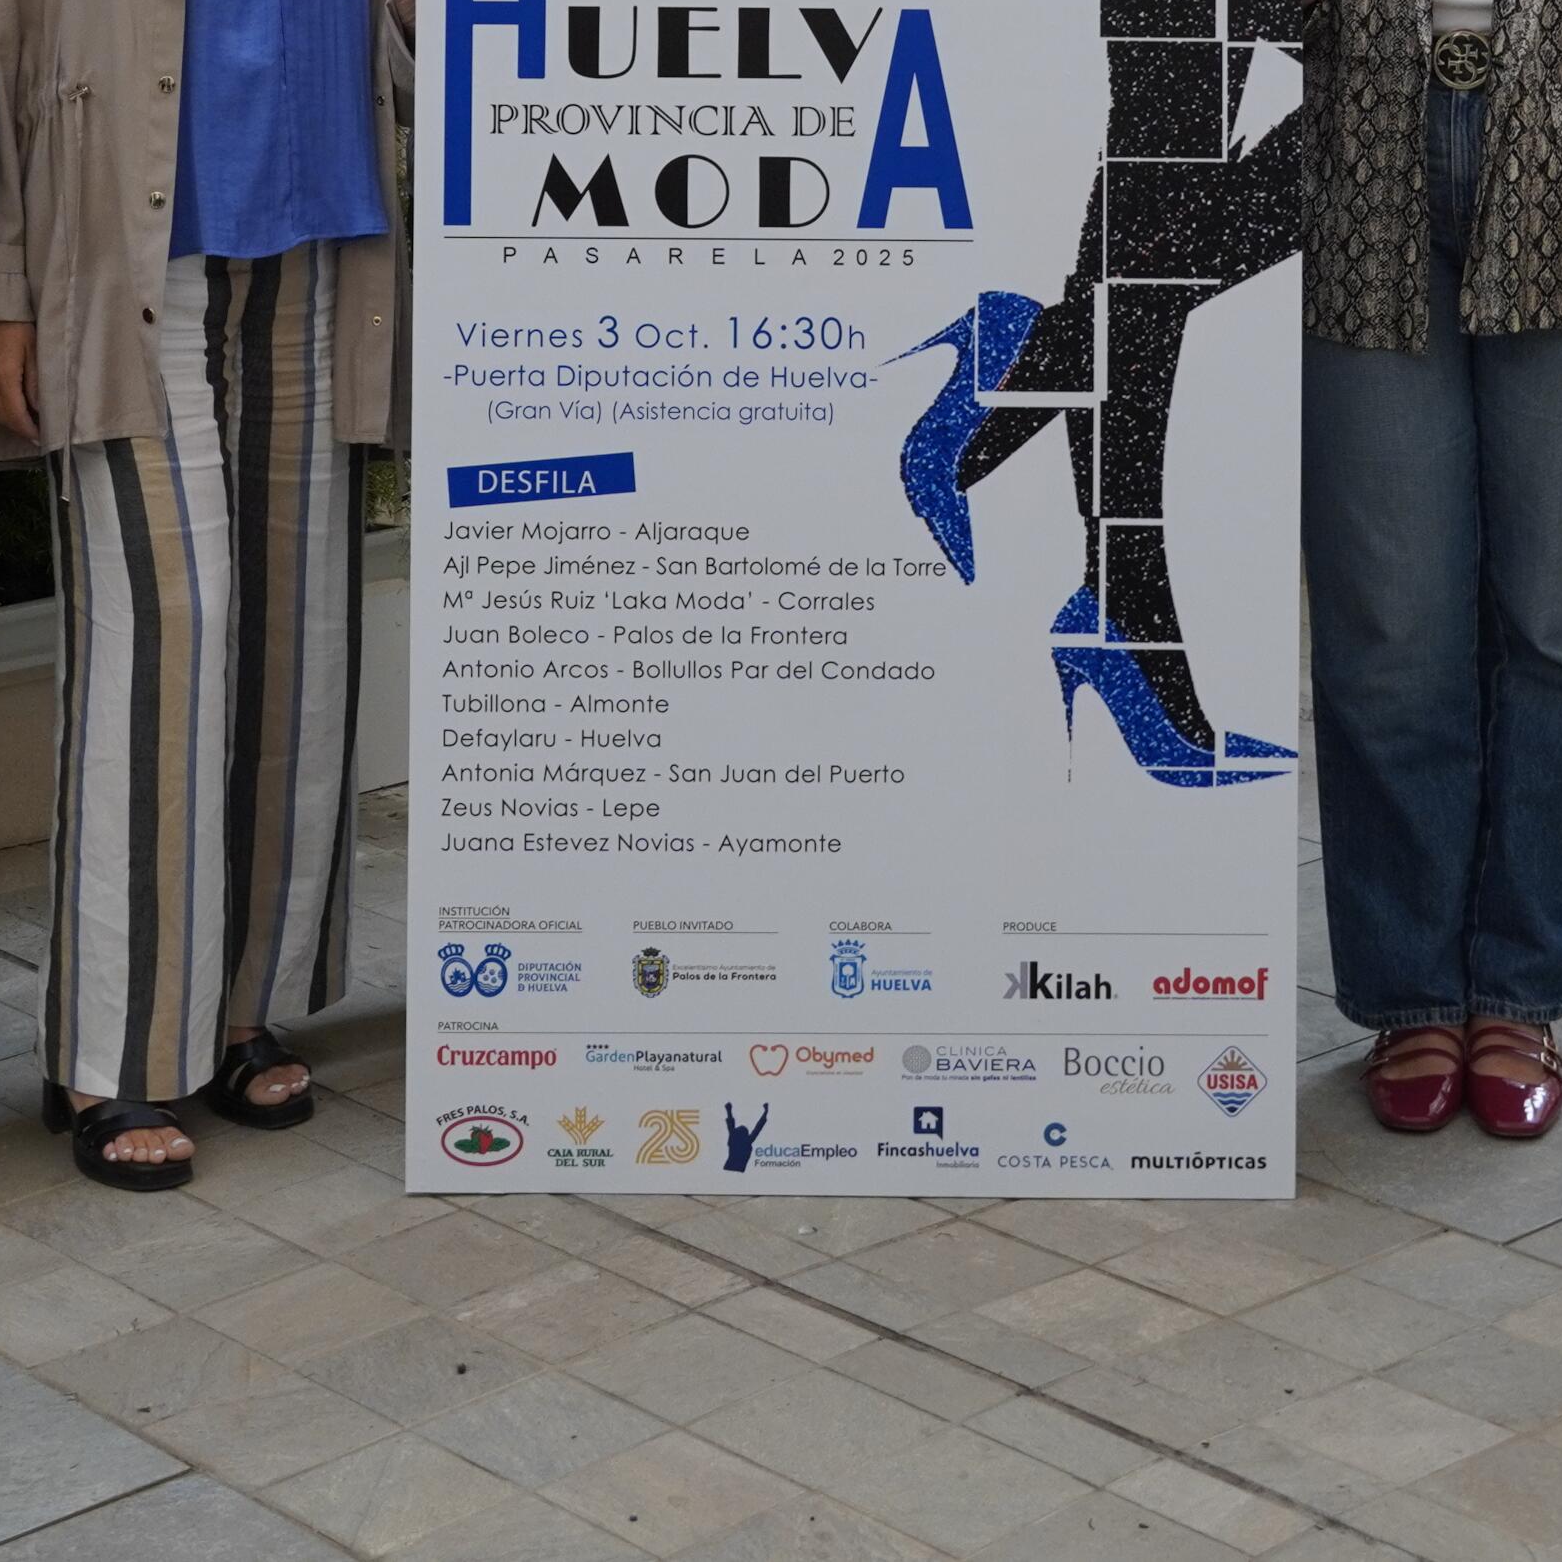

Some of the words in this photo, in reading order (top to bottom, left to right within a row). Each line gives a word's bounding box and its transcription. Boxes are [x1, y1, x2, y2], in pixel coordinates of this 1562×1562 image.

[491, 104, 775, 136] PROVINCIA
[792, 107, 855, 137] DE
[504, 247, 806, 265] PASARELA
[834, 249, 913, 266] 2025
[457, 322, 582, 348] Viernes
[598, 316, 619, 348] 3
[636, 324, 708, 348] Oct.
[730, 317, 864, 350] 16:30h
[558, 364, 711, 392] Diputación
[723, 366, 759, 388] de
[488, 401, 550, 424] (Gran
[560, 400, 601, 424] Vía)
[613, 401, 730, 424] (Asistencia
[739, 402, 833, 425] gratuita)
[479, 470, 599, 496] DESFILA
[444, 521, 513, 539] Javier
[522, 521, 610, 544] Mojarro
[635, 522, 749, 545] Aljaraque
[478, 556, 535, 578] Pepe
[544, 555, 635, 574] Jiménez
[656, 557, 696, 575] San
[706, 556, 820, 575] Bartolomé
[829, 558, 858, 576] de
[867, 558, 885, 576] la
[893, 559, 948, 576] Torre
[444, 590, 472, 608] Mª
[482, 590, 541, 609] Jesús
[552, 591, 595, 609] Ruiz
[779, 592, 874, 610] Corrales
[443, 626, 498, 643] Juan
[509, 625, 589, 644] Boleco
[615, 626, 673, 644] Palos
[683, 626, 712, 644] de
[722, 626, 741, 644] la
[752, 626, 846, 645] Frontera
[443, 660, 534, 678] Antonio
[543, 661, 608, 678] Arcos
[634, 660, 722, 679] Bollullos
[732, 661, 768, 679] Par
[777, 661, 812, 679] del
[822, 661, 934, 679] Condado
[442, 694, 545, 713] Tubillona
[570, 695, 669, 713] Almonte
[443, 729, 555, 751] Defaylaru
[582, 729, 660, 747] Huelva
[442, 763, 533, 782] Antonia
[544, 763, 646, 786] Márquez
[669, 764, 710, 782] San
[720, 765, 775, 783] Juan
[785, 765, 820, 783] del
[831, 765, 904, 783] Puerto
[441, 798, 492, 816] Zeus
[502, 798, 577, 817] Novias
[603, 799, 659, 821] Lepe
[441, 833, 513, 851] Juana
[524, 833, 609, 851] Estevez
[618, 833, 694, 852] Novias
[719, 834, 841, 856] Ayamonte
[439, 905, 509, 916] INSTITUCIÓN
[439, 920, 535, 930] PATROCINADORA
[539, 920, 582, 930] OFICIAL
[633, 921, 676, 930] PUEBLO
[680, 921, 733, 930] INVITADO
[829, 921, 892, 931] COLABORA
[1003, 922, 1056, 931] PRODUCE
[518, 962, 581, 971] DIPUTACIÓN
[673, 972, 700, 980] Palos
[704, 972, 716, 980] de
[731, 972, 776, 980] Frontera
[518, 973, 580, 981] PROVINCIAL
[871, 979, 931, 990] HUELVA
[1153, 967, 1268, 999] adomof
[438, 1022, 498, 1030] PATROCINA
[437, 1044, 557, 1069] Cruzcampo
[586, 1048, 722, 1065] GardenPlayanatural
[796, 1046, 874, 1069] Obymed
[937, 1059, 1035, 1071] BAVIERA
[1065, 1046, 1164, 1076] Boccio
[662, 1064, 675, 1072] Spa
[1100, 1076, 1174, 1095] estética
[1207, 1074, 1260, 1092] USISA
[436, 1108, 465, 1128] FRES
[507, 1110, 529, 1128] S.A.
[577, 1149, 613, 1157] RURAL
[755, 1144, 857, 1161] educaEmpleo
[878, 1142, 979, 1157] Fincashuelva
[556, 1158, 578, 1166] DEL
[583, 1159, 605, 1167] SUR
[755, 1159, 801, 1167] Formación
[998, 1155, 1051, 1168] COSTA
